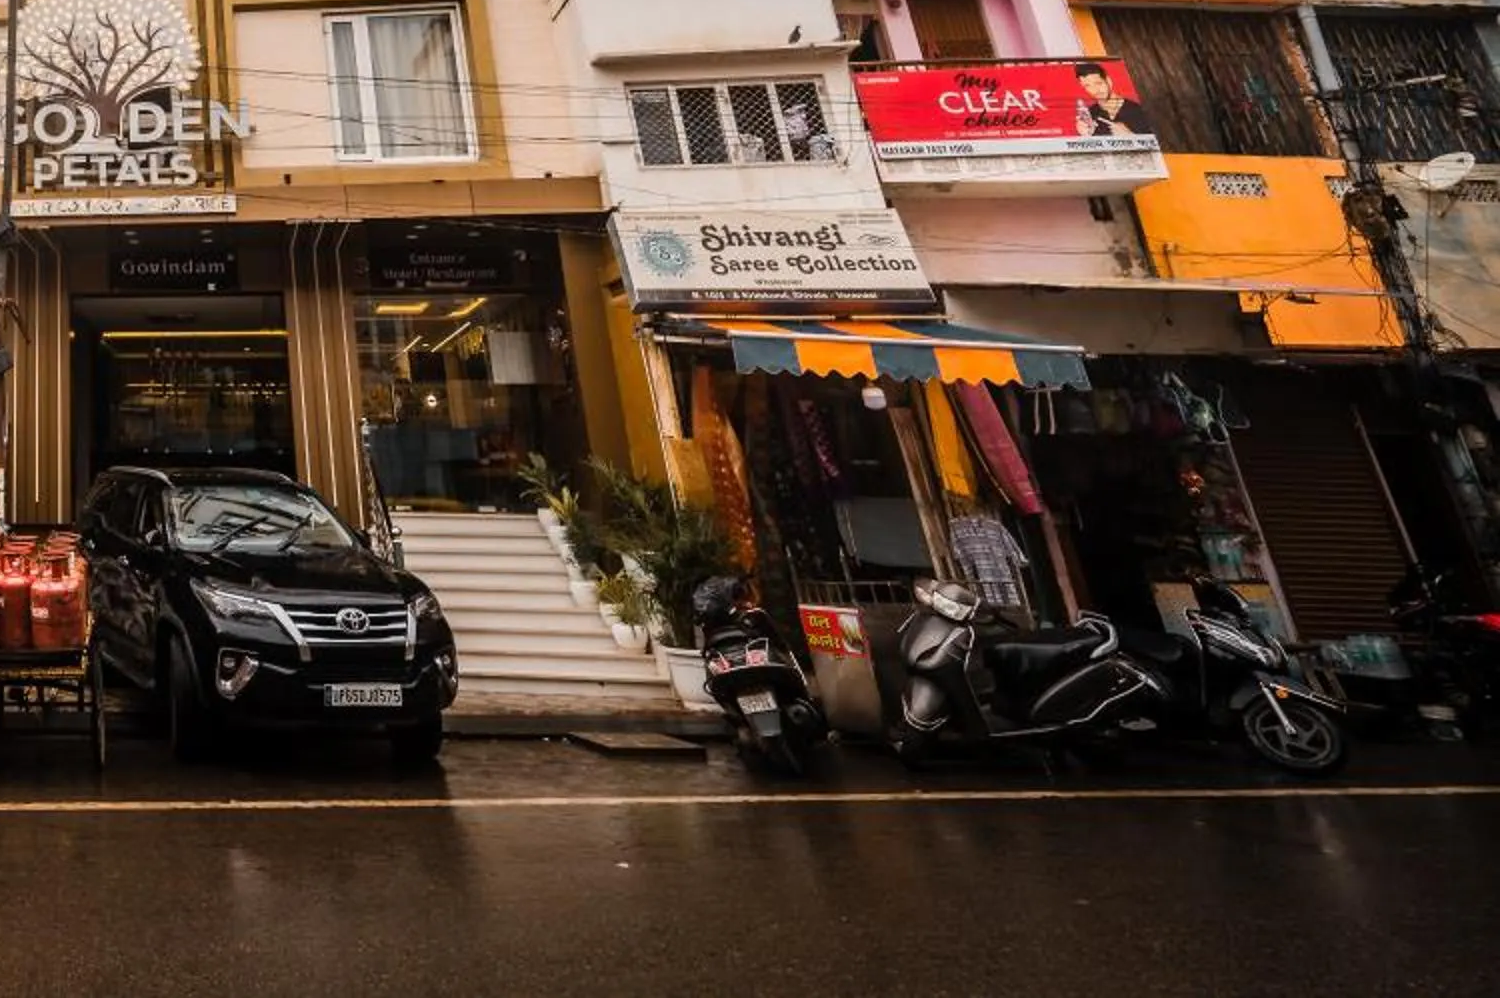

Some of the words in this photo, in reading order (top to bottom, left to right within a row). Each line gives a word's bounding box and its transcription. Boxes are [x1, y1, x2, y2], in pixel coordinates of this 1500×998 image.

[939, 89, 1048, 113] CLEAR
[963, 109, 1040, 129] choice
[33, 153, 198, 189] PETALS
[700, 223, 846, 252] Shivangi
[121, 259, 226, 275] Govindam
[710, 255, 779, 275] Saree
[786, 255, 917, 275] Collection
